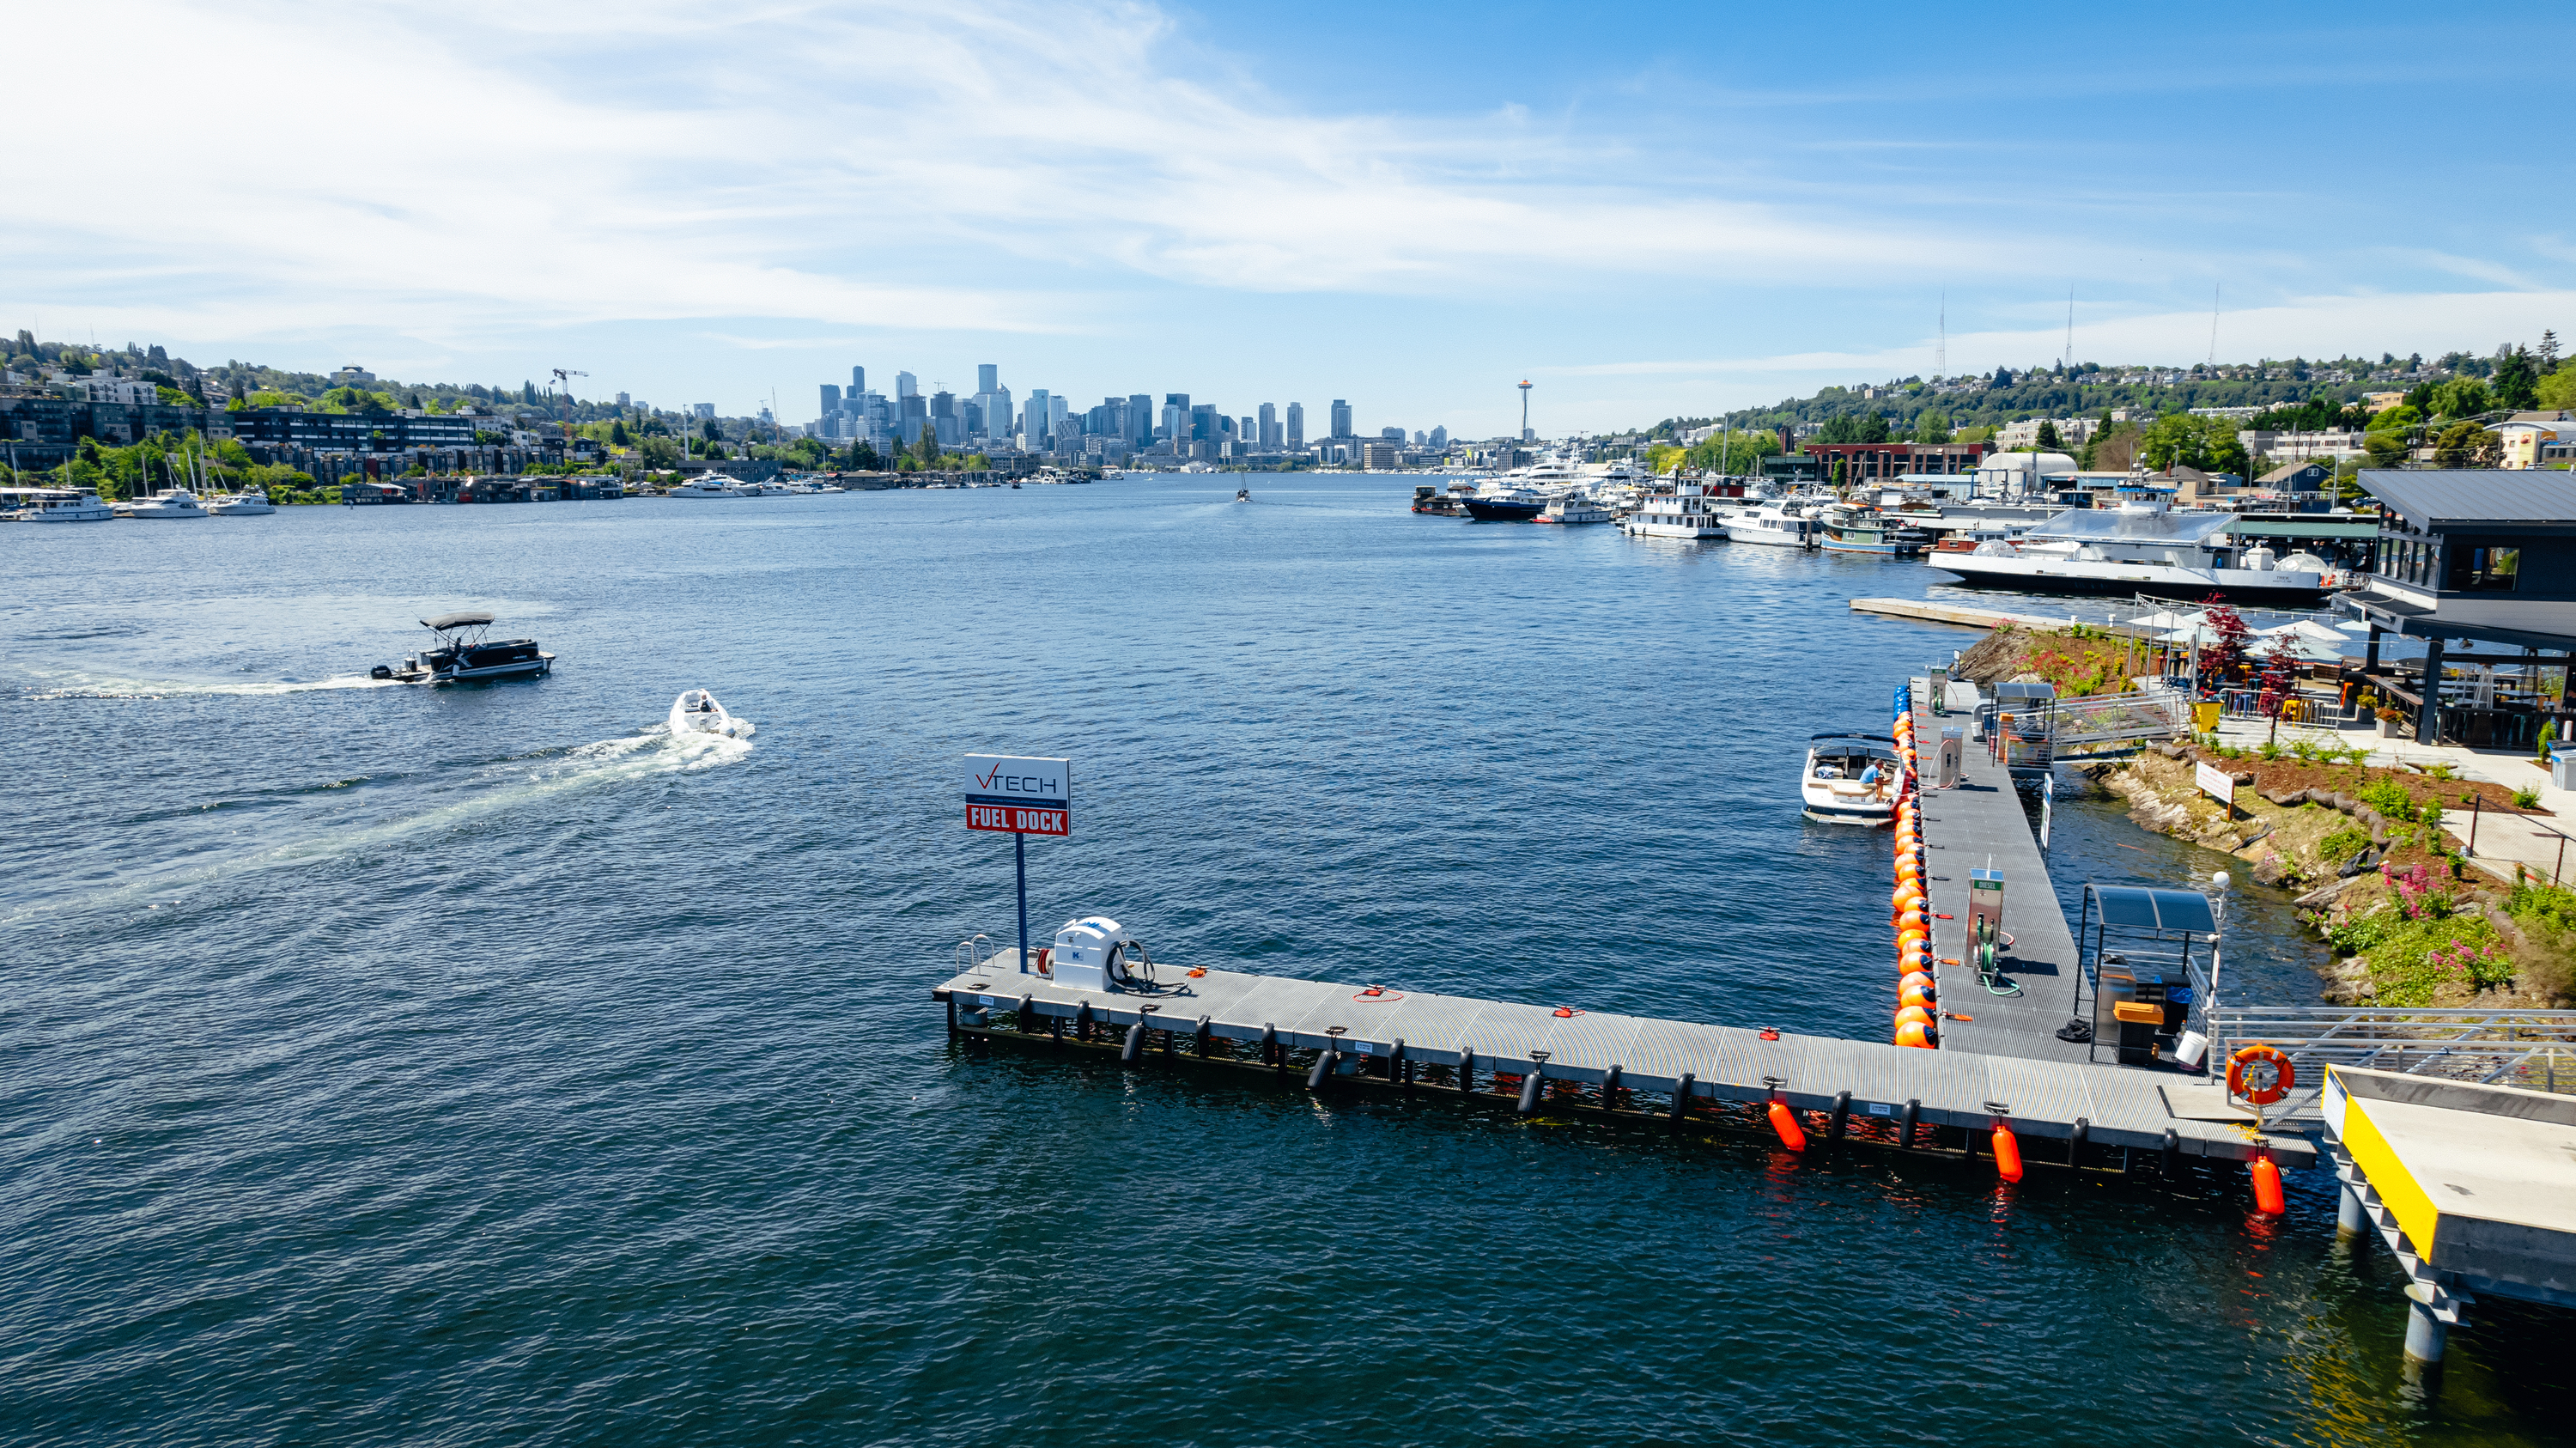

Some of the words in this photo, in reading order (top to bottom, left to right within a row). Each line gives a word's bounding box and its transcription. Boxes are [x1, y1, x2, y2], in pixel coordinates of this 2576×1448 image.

[975, 761, 1056, 794] VTECH
[971, 807, 1010, 828] FUEL
[1016, 810, 1063, 831] DOCK
